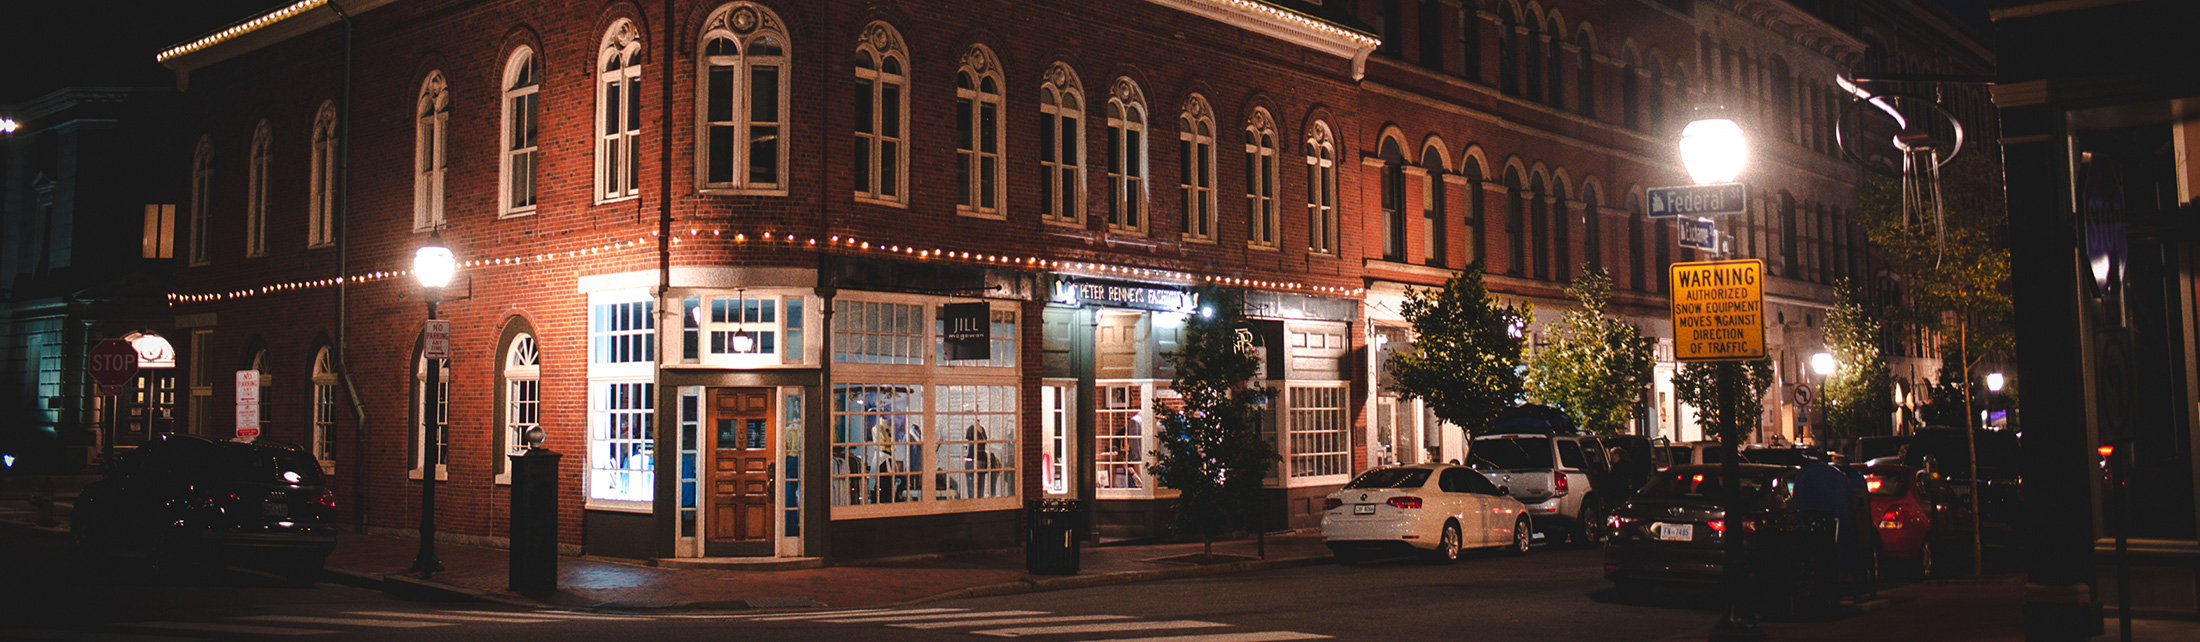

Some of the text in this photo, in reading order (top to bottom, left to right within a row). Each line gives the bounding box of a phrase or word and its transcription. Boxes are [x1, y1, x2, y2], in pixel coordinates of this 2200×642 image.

[1667, 189, 1724, 213] Federal
[1679, 267, 1754, 287] WARNING
[1080, 283, 1105, 300] PETER
[1686, 288, 1748, 300] AUTHORIZED
[1675, 301, 1759, 315] SNOW EQUIPMENT
[953, 317, 979, 334] JILL
[1680, 314, 1756, 327] MOVES AGAINST
[1693, 328, 1744, 340] DIRECTION
[1690, 341, 1748, 354] OF TRAFFIC
[92, 354, 135, 371] STOP
